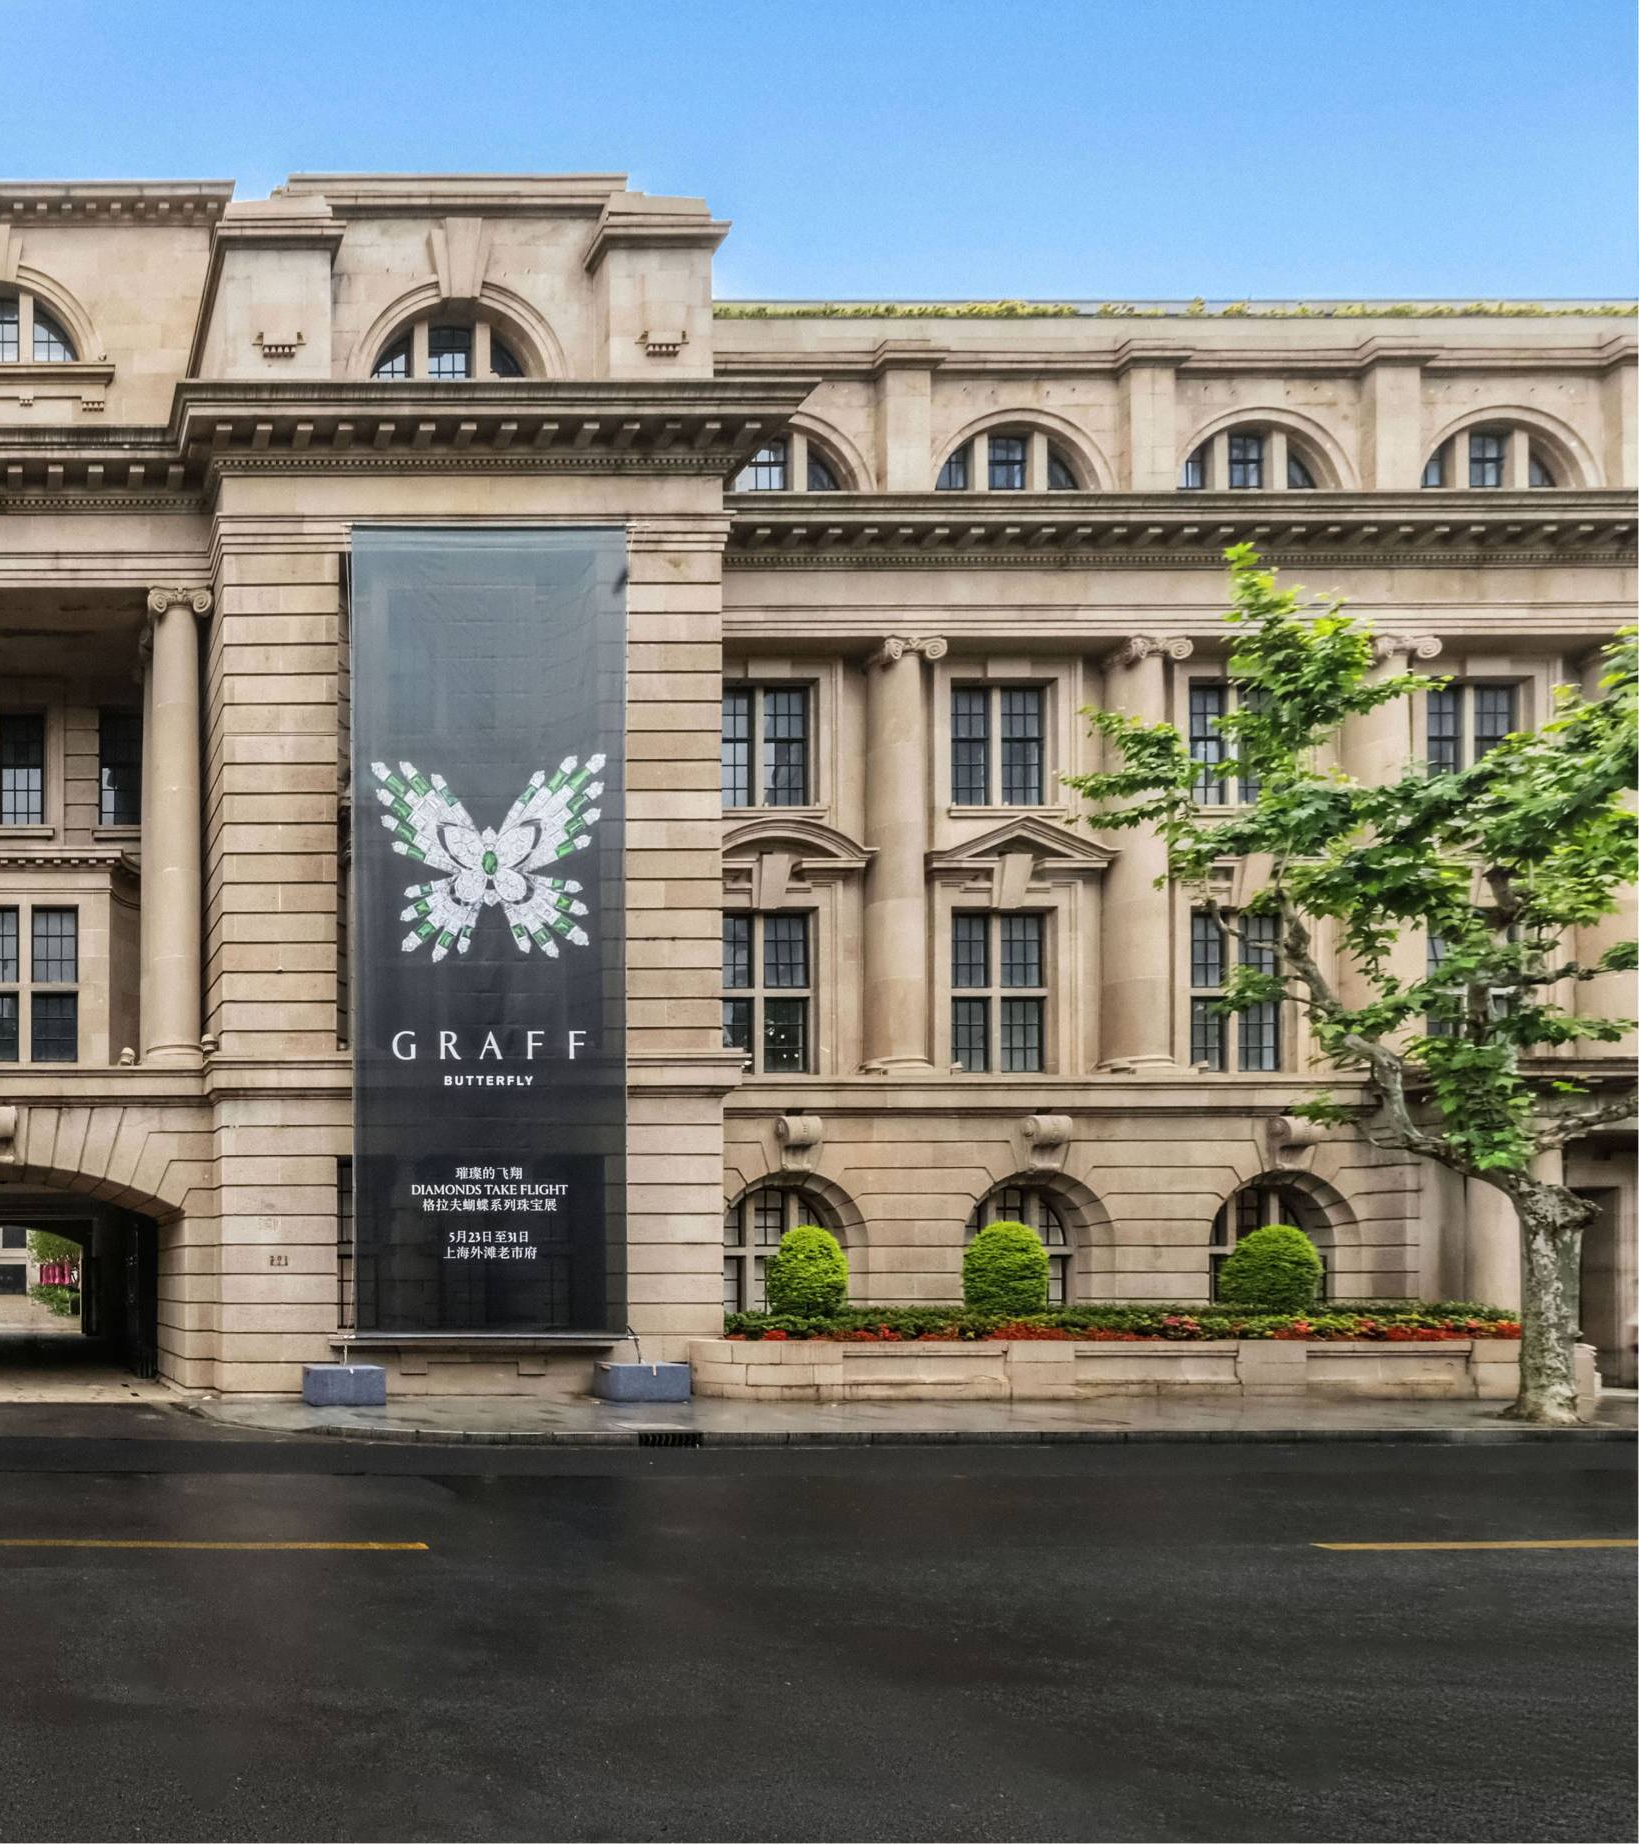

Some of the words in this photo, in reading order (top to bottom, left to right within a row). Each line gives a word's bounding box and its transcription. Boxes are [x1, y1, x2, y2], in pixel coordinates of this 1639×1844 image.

[392, 1030, 587, 1060] GRAFF
[444, 1076, 533, 1085] BUTTERFLY
[455, 1167, 523, 1180] 璀璨的飞翔
[411, 1184, 482, 1195] DIAMONDS
[484, 1184, 517, 1195] TAKE
[520, 1184, 569, 1195] FLIGHT
[423, 1199, 557, 1212] 格拉夫蝴蝶系列珠宝展
[443, 1246, 537, 1259] 上海外滩老市府
